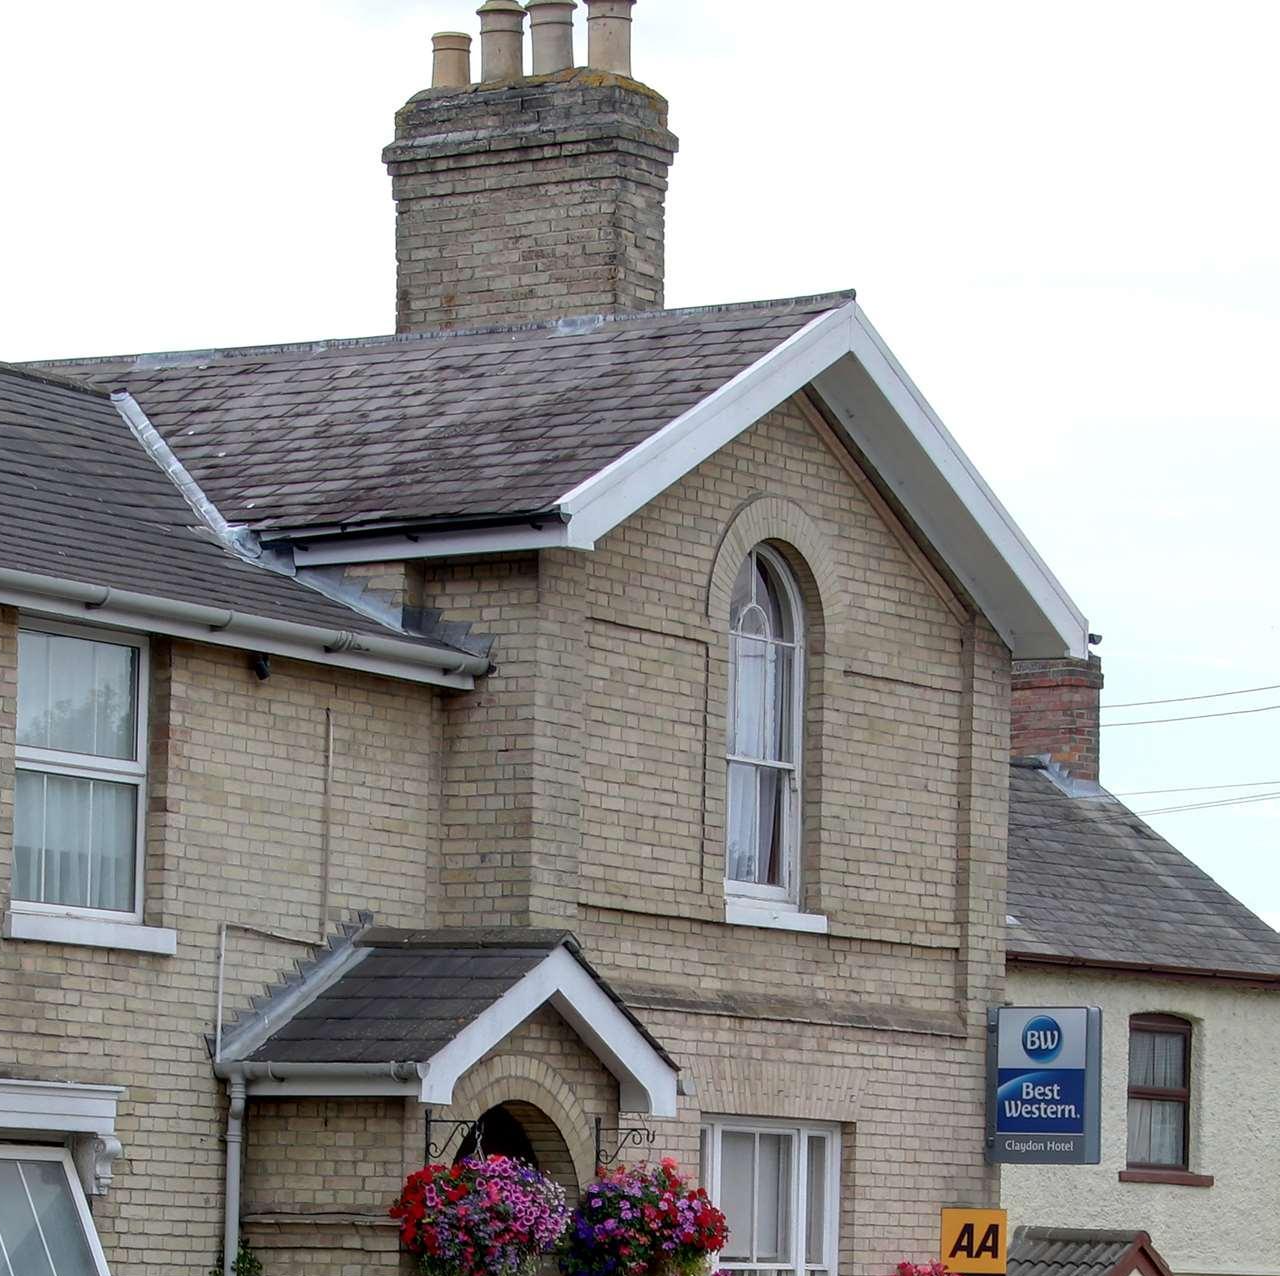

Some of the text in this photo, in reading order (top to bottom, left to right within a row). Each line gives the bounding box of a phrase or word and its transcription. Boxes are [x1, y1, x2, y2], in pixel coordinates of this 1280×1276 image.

[1026, 1030, 1059, 1051] BW
[1022, 1081, 1061, 1100] Best
[1005, 1140, 1074, 1153] Claydon Hotel
[948, 1223, 1000, 1259] AA
